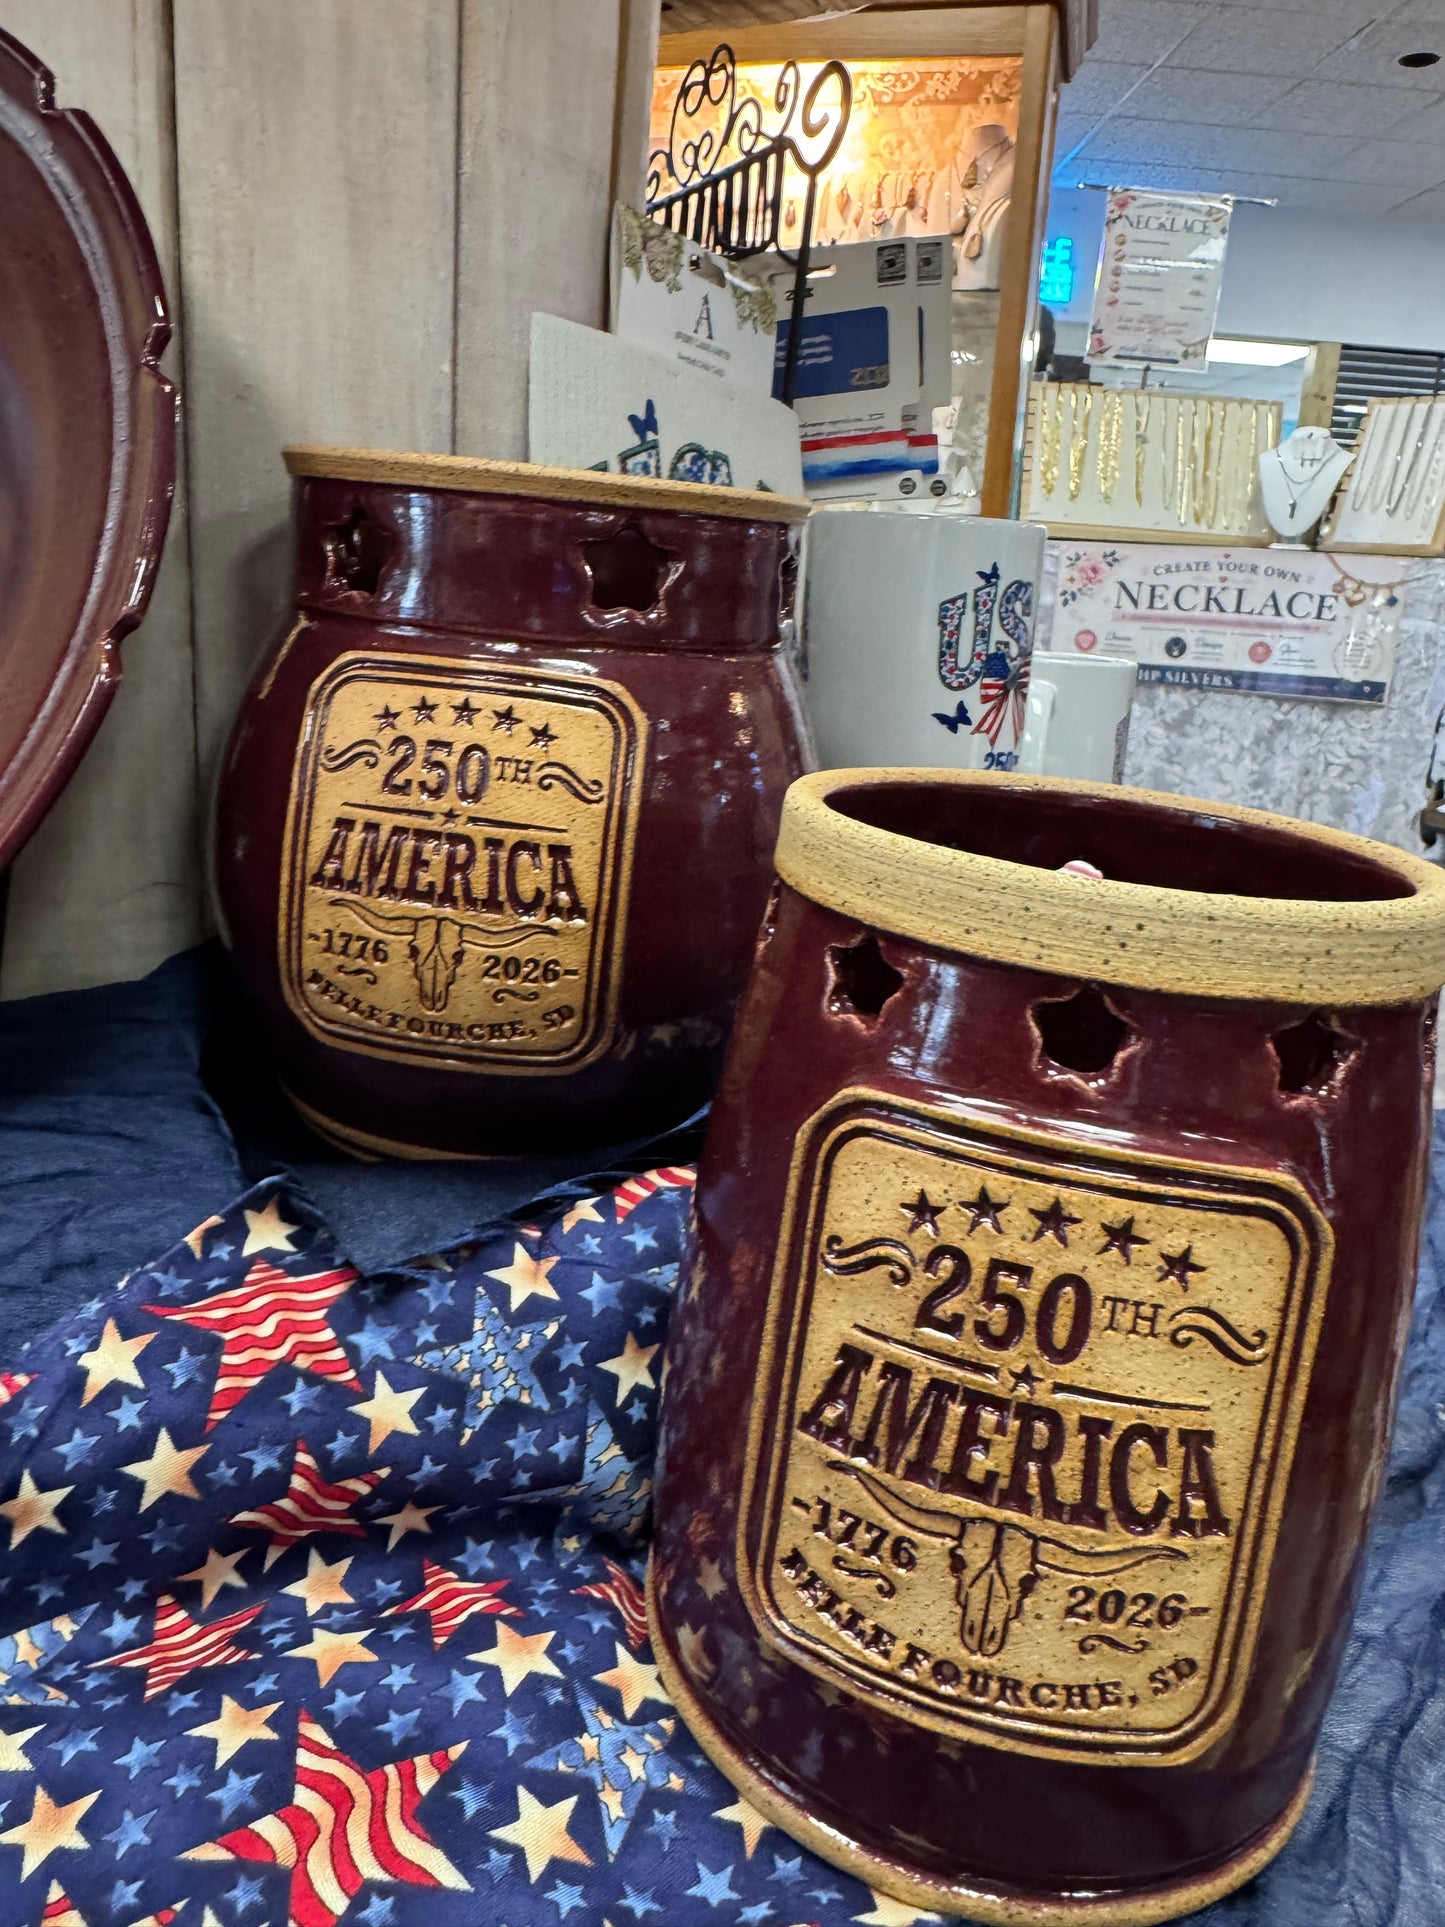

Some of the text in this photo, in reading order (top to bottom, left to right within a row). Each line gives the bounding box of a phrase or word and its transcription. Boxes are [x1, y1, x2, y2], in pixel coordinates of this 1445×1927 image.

[1153, 560, 1301, 582] CREATE YOUR OWN
[1114, 580, 1338, 621] NECKLACE
[309, 816, 587, 925] AMERICA
[541, 1004, 575, 1031] SD
[799, 1343, 1231, 1539] AMERICA
[1149, 1656, 1199, 1697] SD
